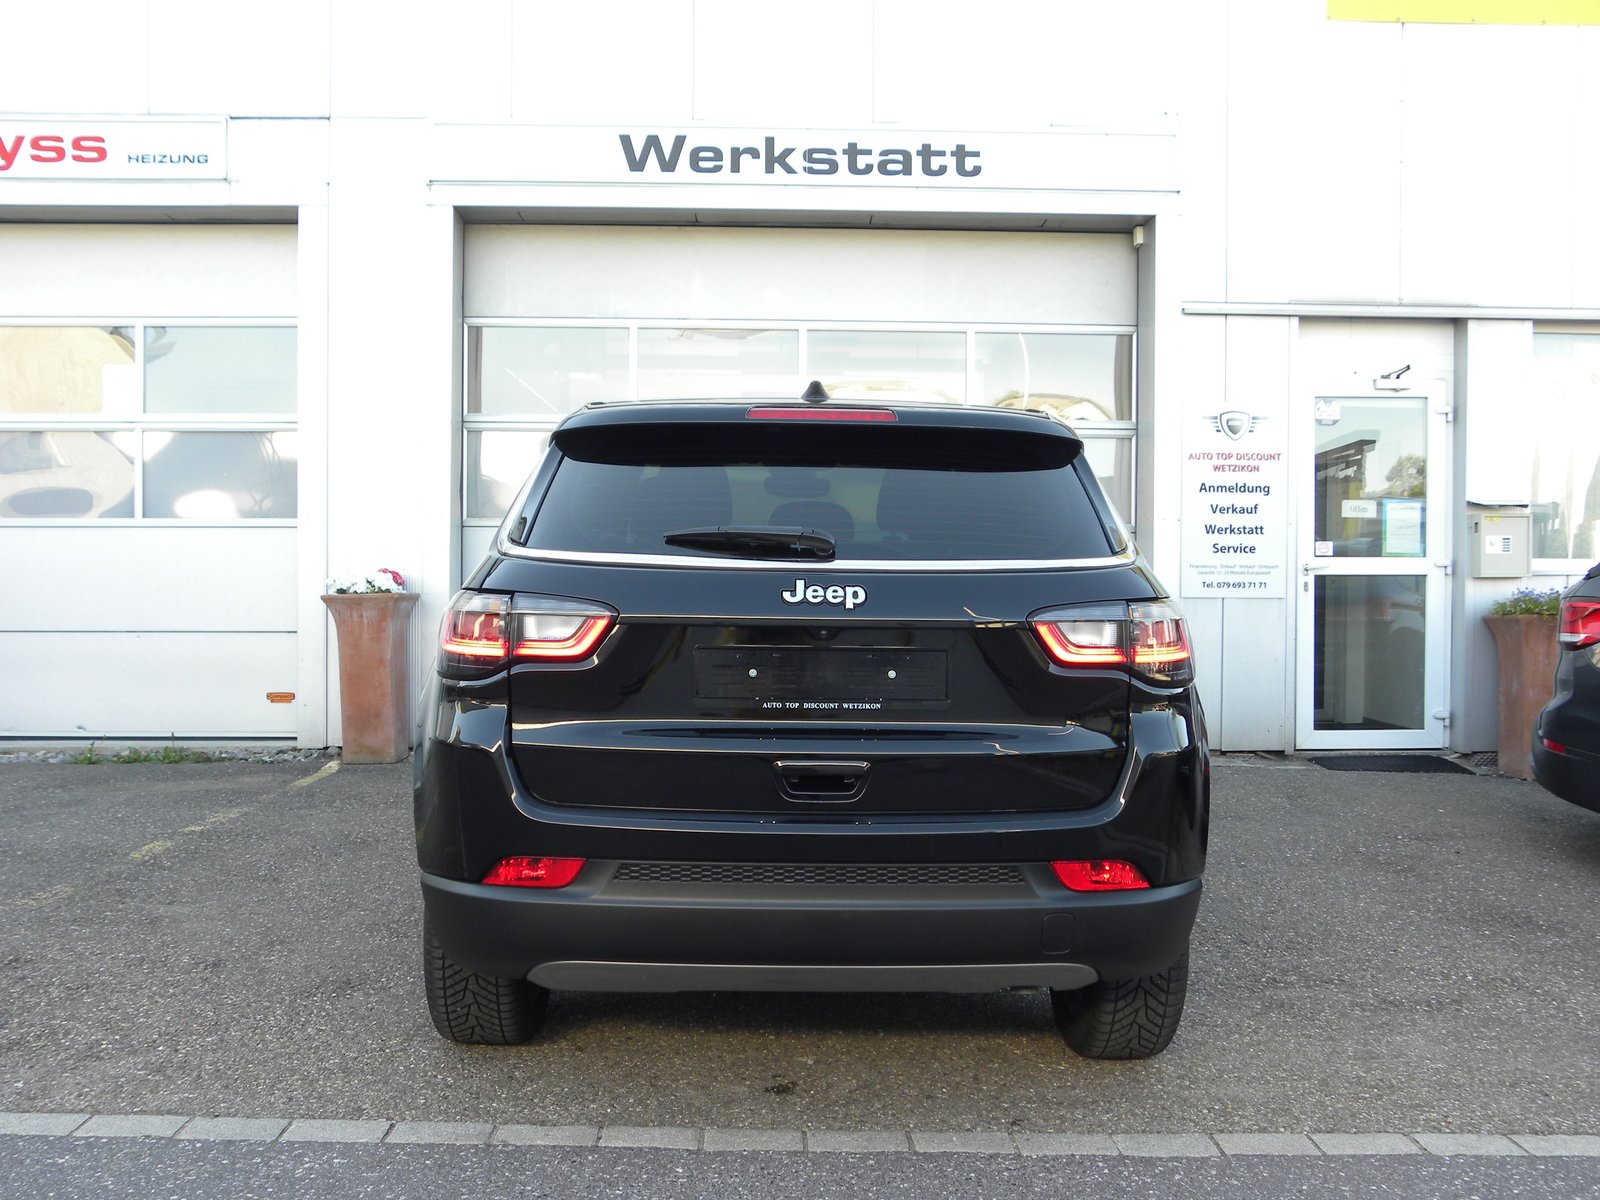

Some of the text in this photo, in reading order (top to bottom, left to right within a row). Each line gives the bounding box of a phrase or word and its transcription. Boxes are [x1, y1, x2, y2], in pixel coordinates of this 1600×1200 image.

[127, 154, 209, 164] HEIZUNG
[618, 134, 982, 177] Werkstatt
[1188, 453, 1281, 461] AUTO TOP DISCOUNT
[1199, 482, 1270, 496] Anmeldung
[1210, 503, 1259, 514] Verkauf
[1204, 524, 1264, 535] Werkstatt
[1212, 543, 1256, 553] Service
[781, 578, 867, 609] Jeep
